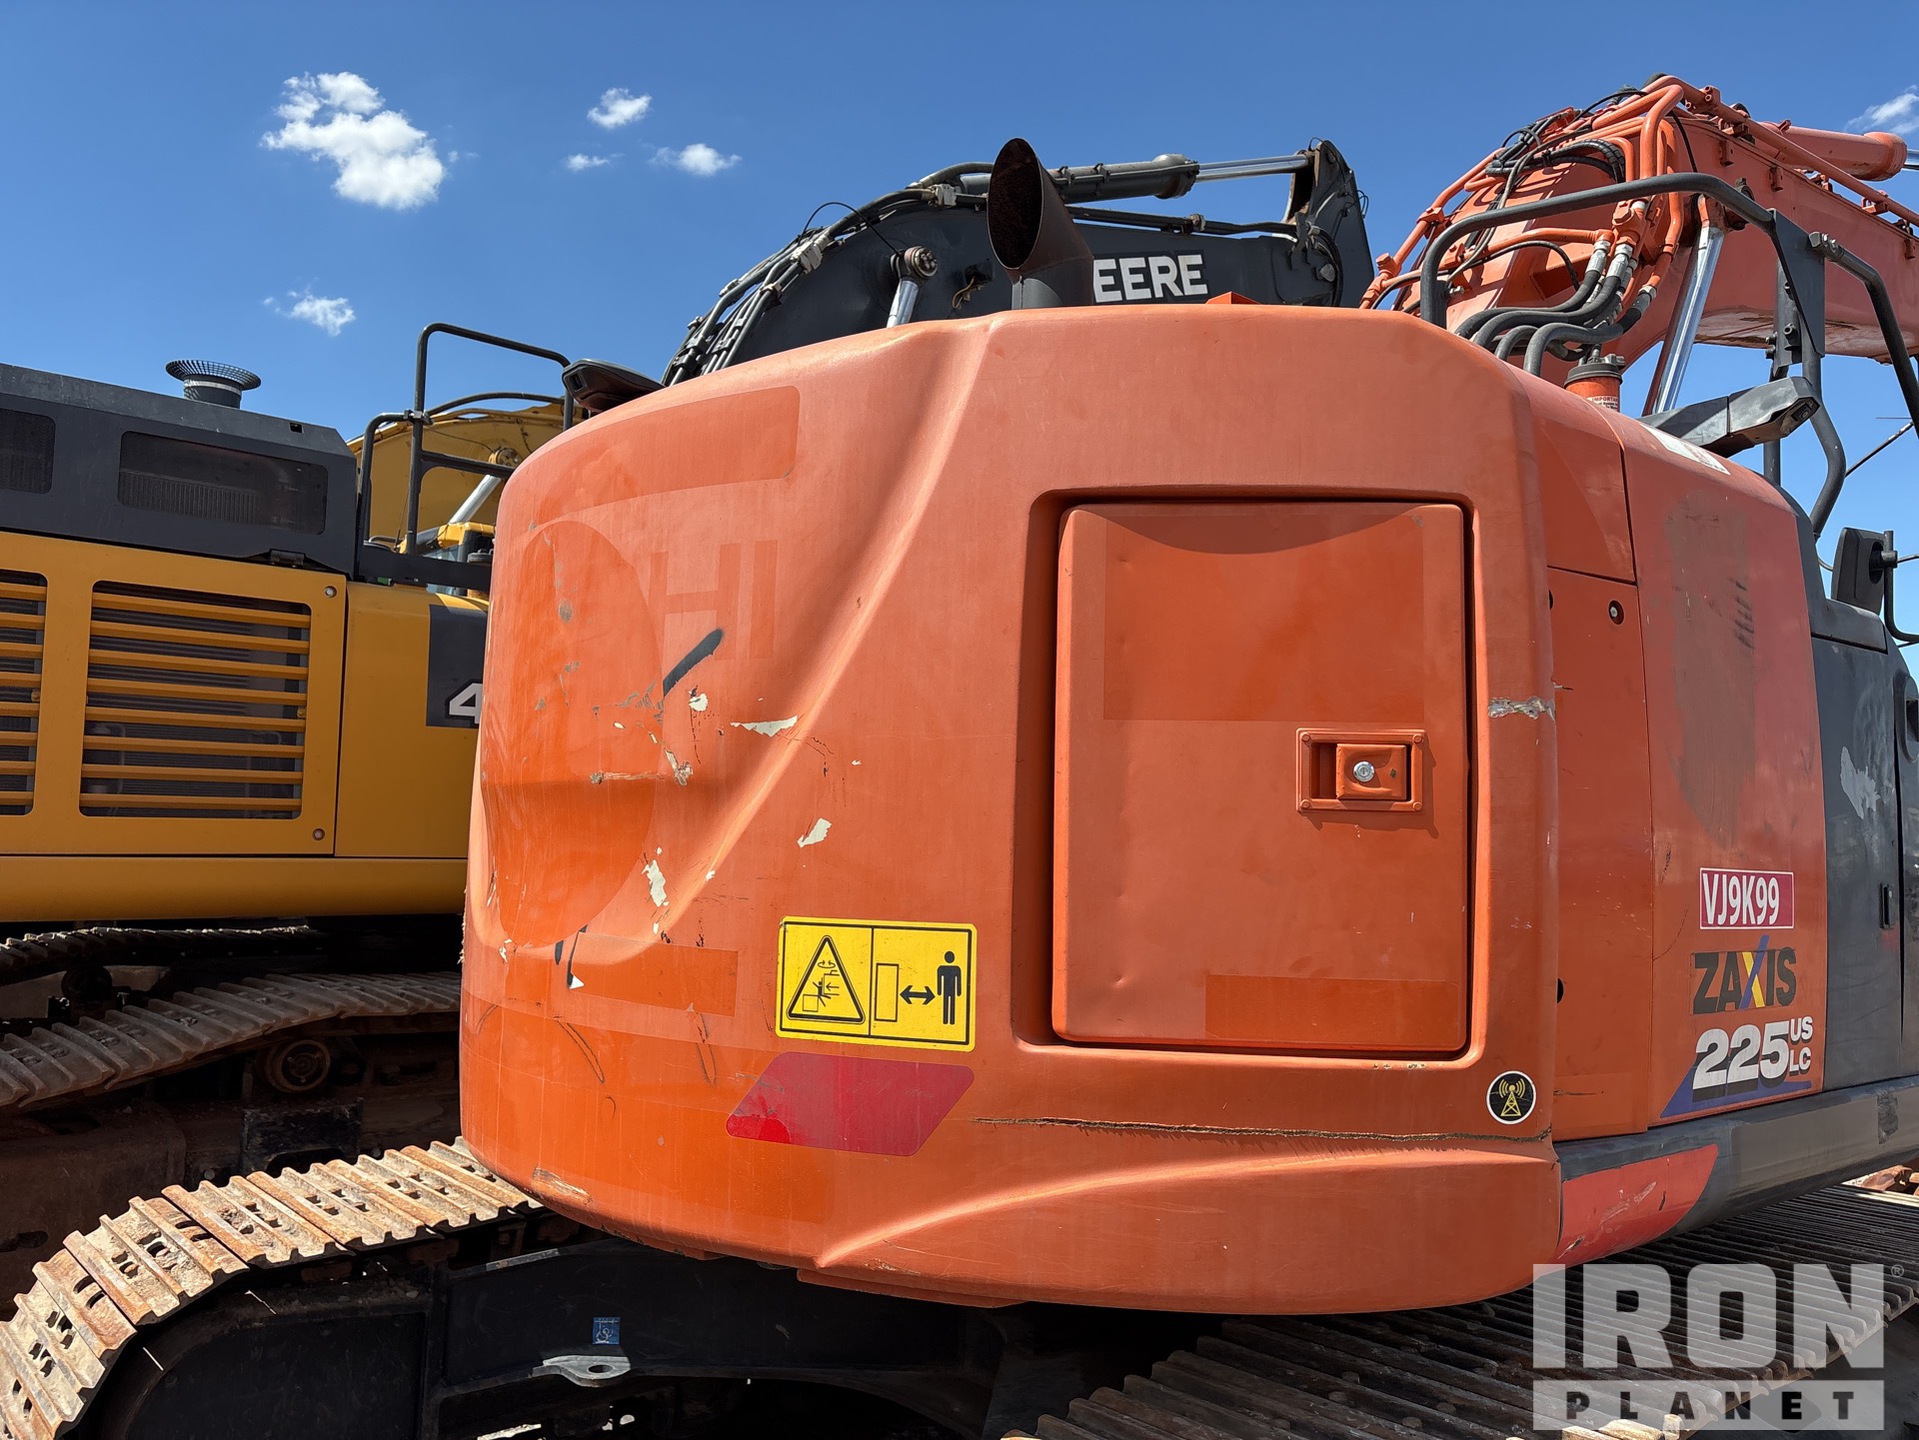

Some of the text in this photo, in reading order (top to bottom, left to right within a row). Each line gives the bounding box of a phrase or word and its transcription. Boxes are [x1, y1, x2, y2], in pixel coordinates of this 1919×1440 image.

[1093, 254, 1208, 303] EERE
[448, 682, 483, 724] 4
[1702, 873, 1780, 926] VJ9K99
[1693, 935, 1797, 1014] ZAXIS
[1692, 1016, 1813, 1098] 225 US
[1789, 1046, 1811, 1073] LC
